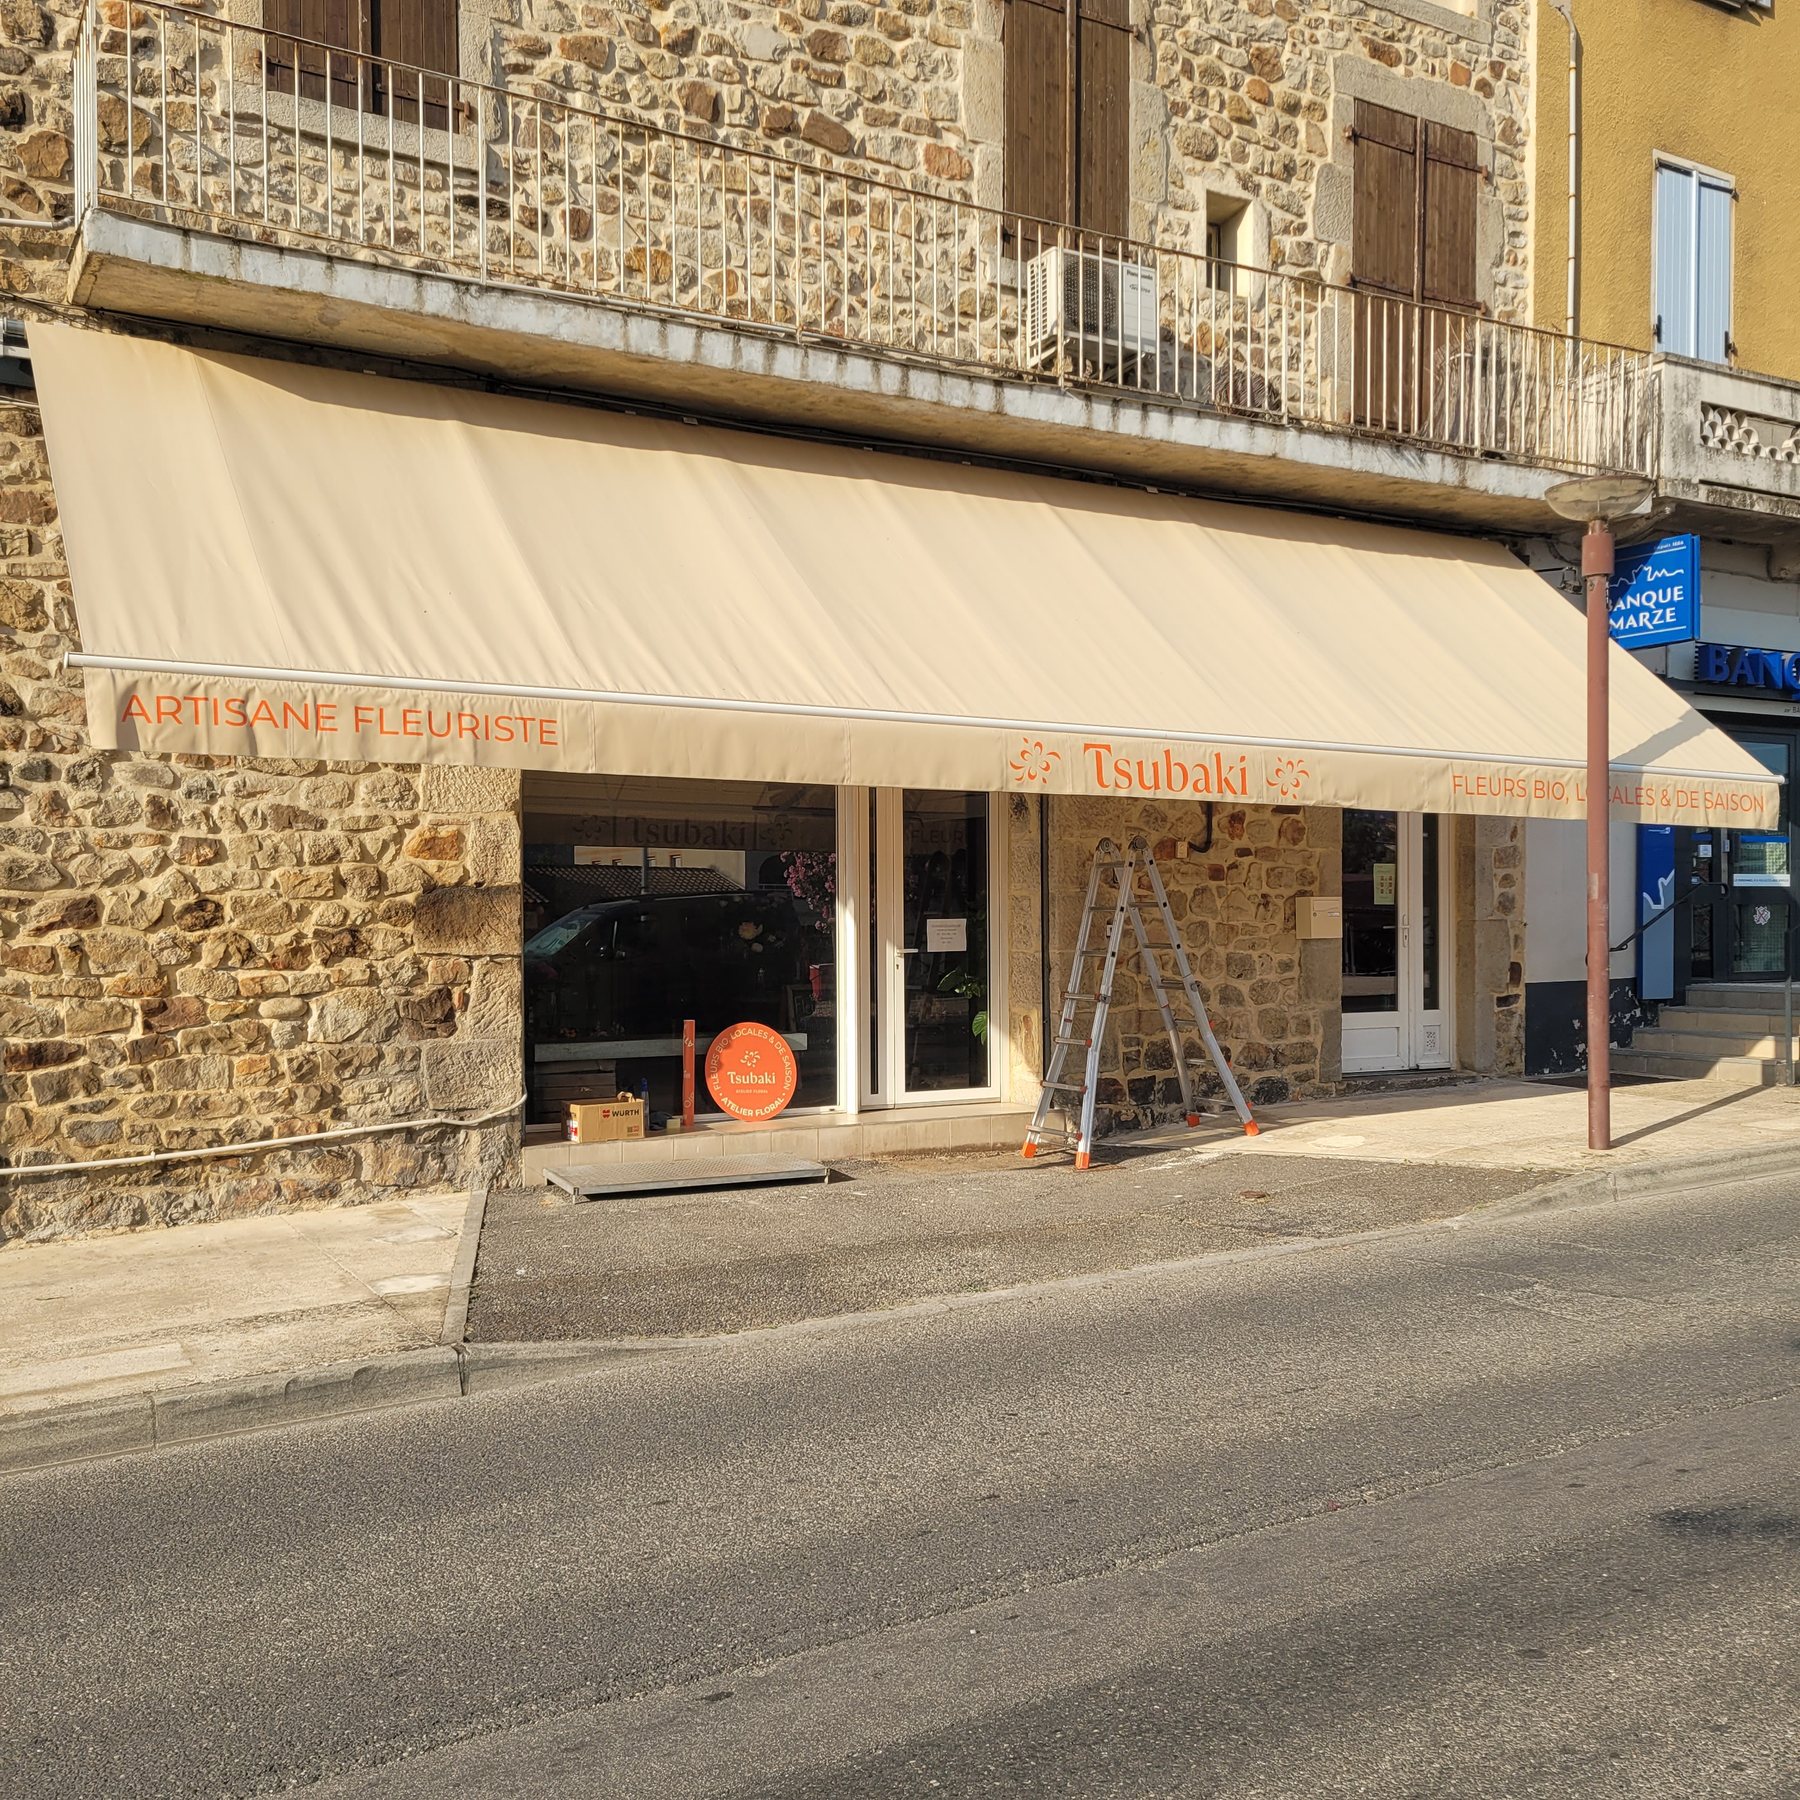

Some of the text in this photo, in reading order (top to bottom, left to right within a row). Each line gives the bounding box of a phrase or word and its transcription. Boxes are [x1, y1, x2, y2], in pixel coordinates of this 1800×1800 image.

[1609, 607, 1677, 630] MARZE
[122, 694, 559, 747] ARTISANE FLEURISTE
[1083, 743, 1249, 796] Tsubaki
[1452, 774, 1765, 813] FLEURS BIO, LALES & DE SAISON
[710, 1053, 721, 1092] FLEURS
[731, 1027, 769, 1040] LOCALES
[774, 1041, 786, 1055] DE
[782, 1055, 793, 1090] SAISON
[727, 1071, 776, 1085] Tsubaki
[720, 1096, 754, 1117] ATELIER
[755, 1096, 785, 1117] FLORAL
